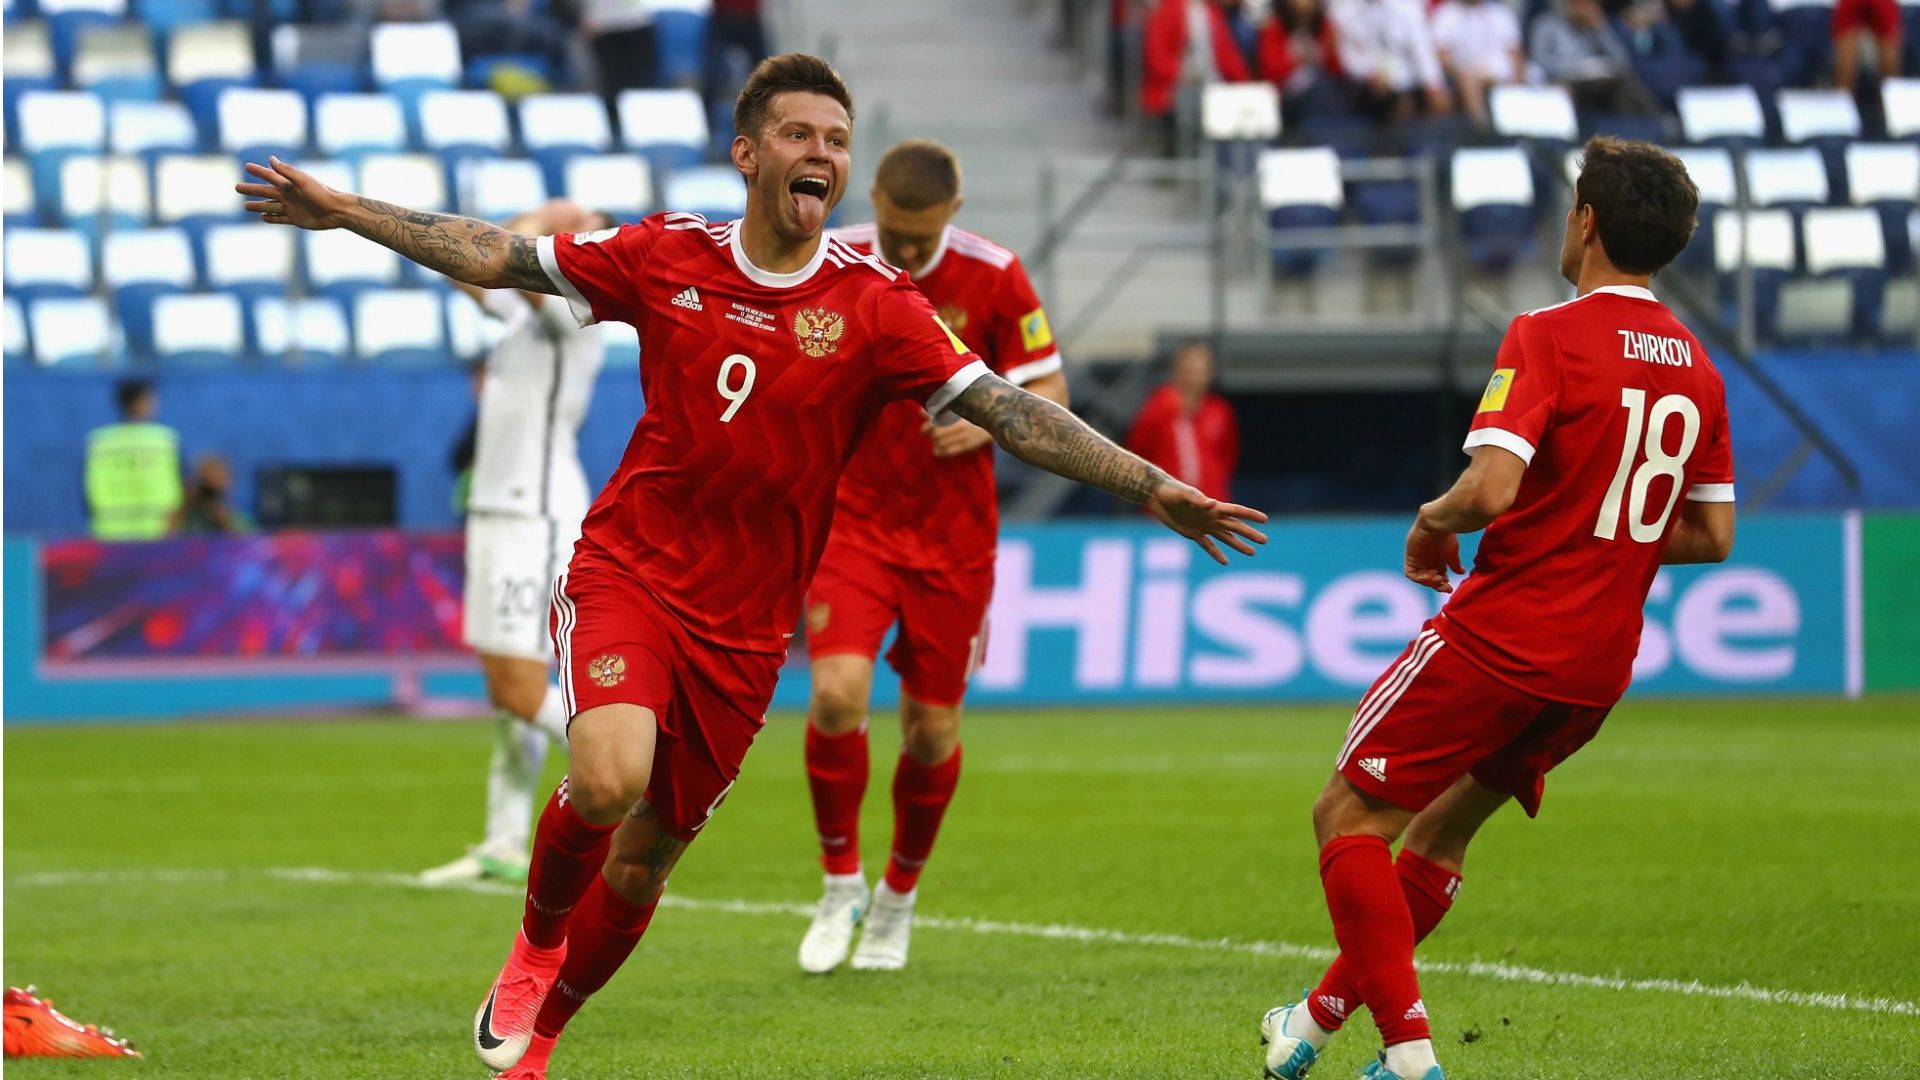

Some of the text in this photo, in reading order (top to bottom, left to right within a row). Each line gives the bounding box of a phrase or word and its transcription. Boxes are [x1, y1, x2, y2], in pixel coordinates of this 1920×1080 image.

[671, 297, 703, 312] adidas
[1618, 329, 1692, 368] ZHIRKOV
[716, 353, 757, 423] 9
[1593, 387, 1700, 544] 18
[978, 539, 1800, 684] Hisee
[1358, 759, 1387, 782] adidas
